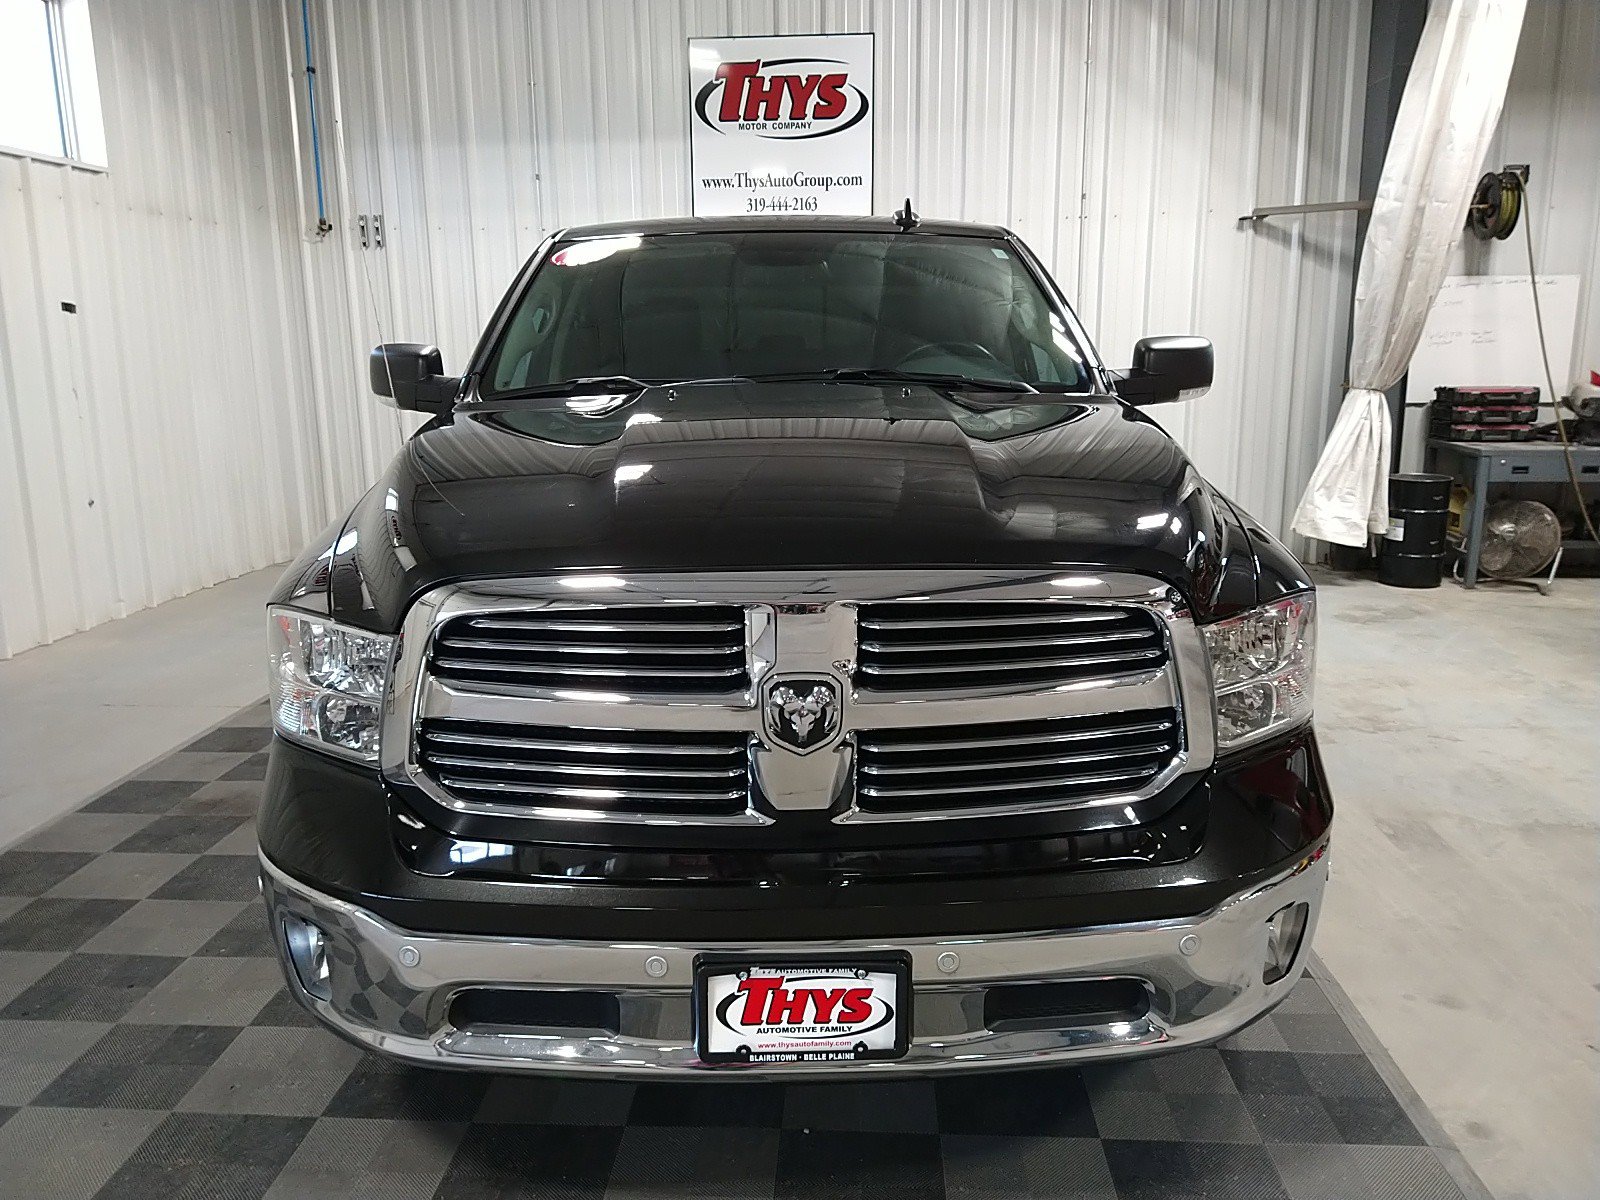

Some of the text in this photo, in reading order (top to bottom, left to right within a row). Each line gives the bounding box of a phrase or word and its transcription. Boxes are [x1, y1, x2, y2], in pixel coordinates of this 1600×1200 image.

[714, 58, 849, 122] THYS
[738, 121, 812, 131] MOTOR COMPANY
[702, 171, 863, 193] www.ThysAutoGroup.com
[746, 196, 818, 212] 319-444-2163
[738, 976, 874, 1026] THYS
[756, 1025, 853, 1034] AUTOMOTIVE FAMILY
[757, 1040, 852, 1050] www.thysautofamily.com
[749, 1053, 797, 1062] BLAIRSTOWN
[803, 1053, 827, 1061] BELLE
